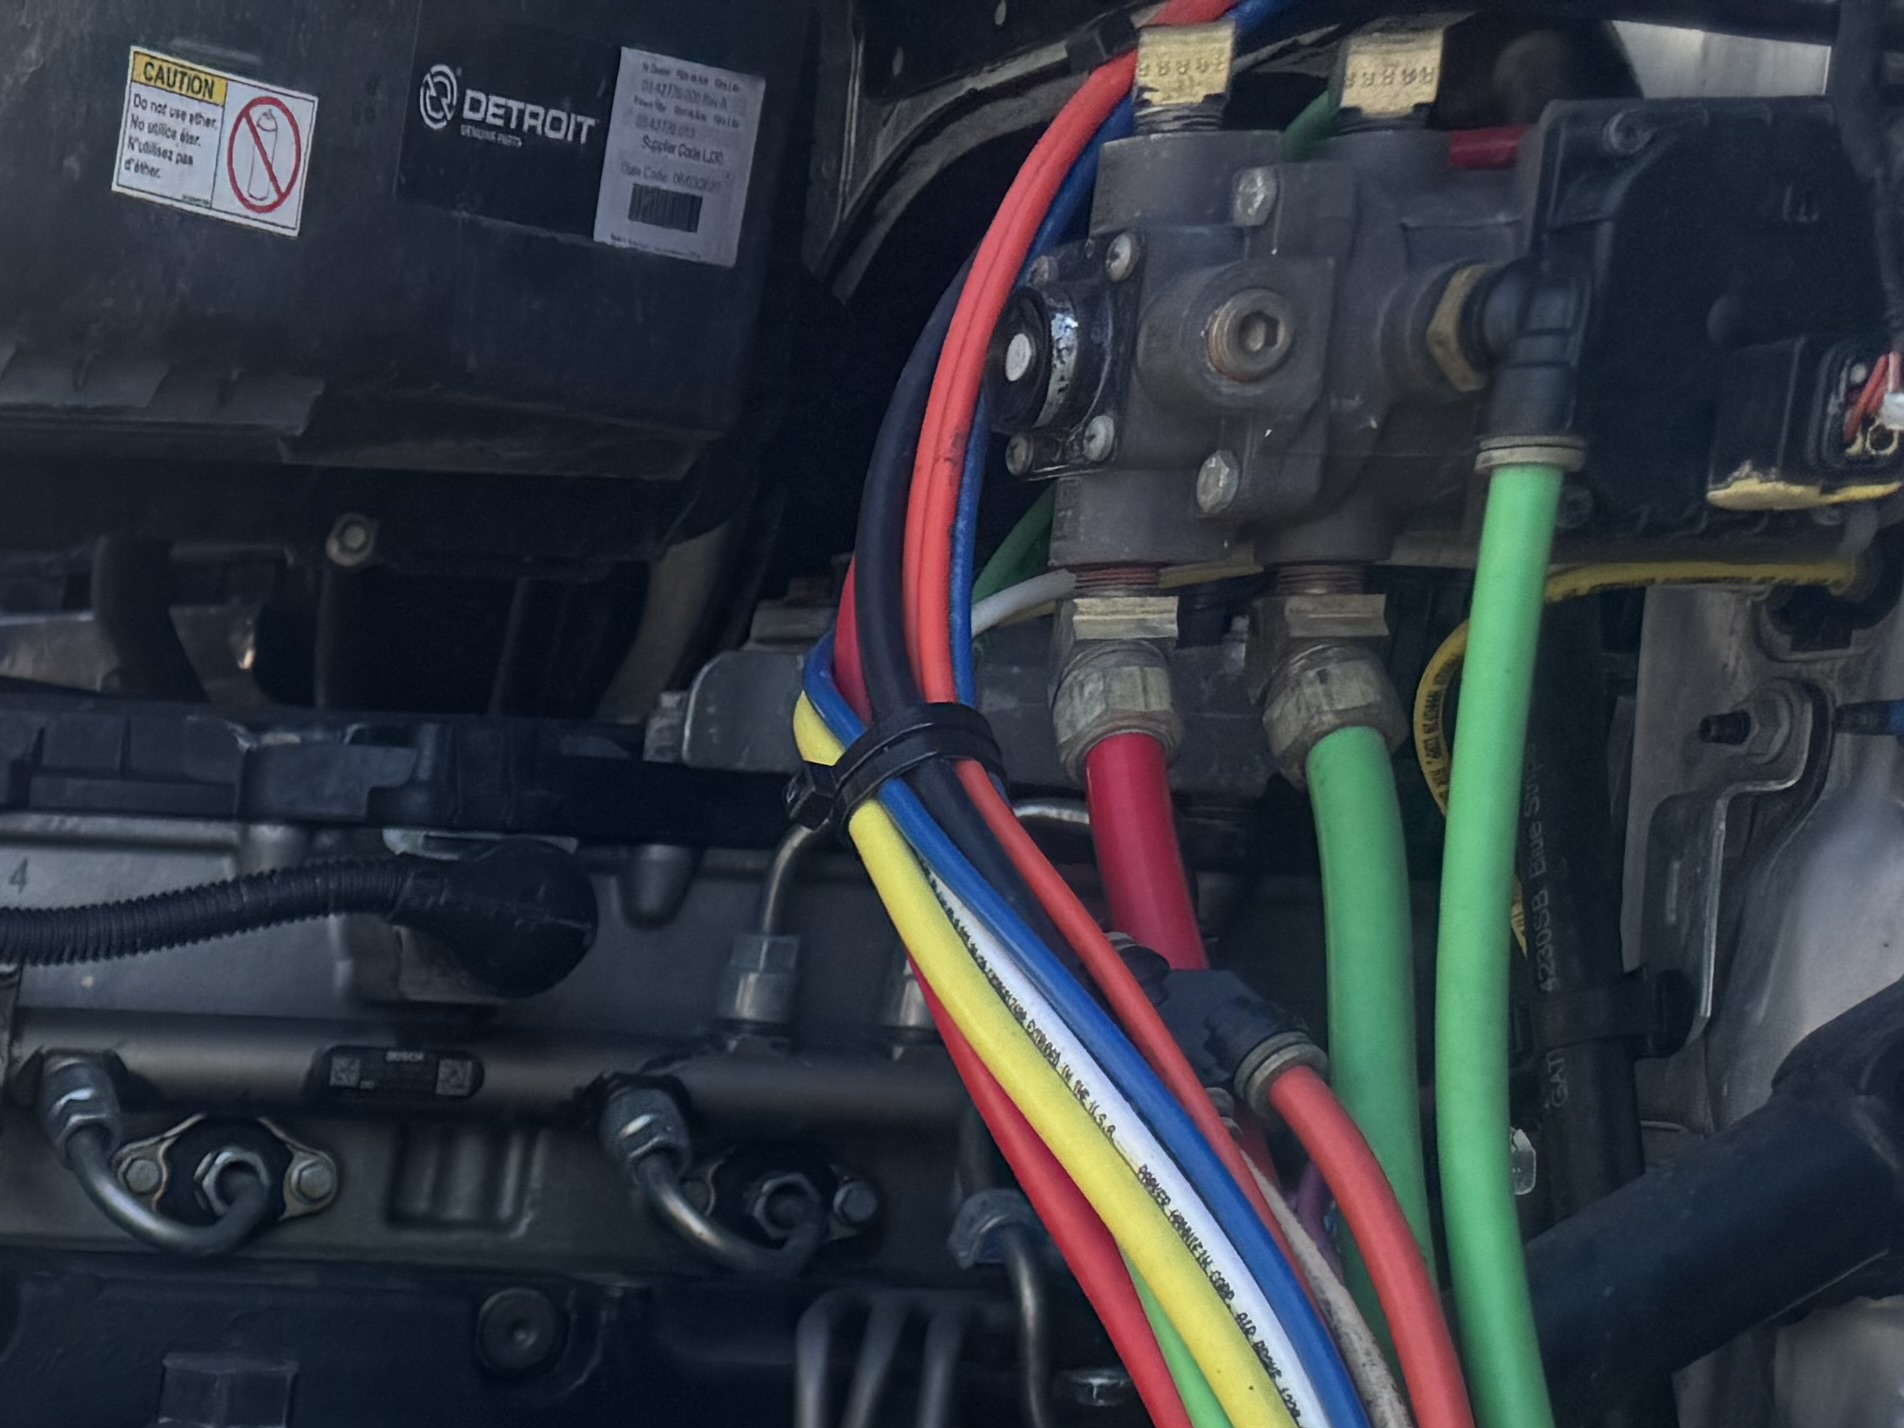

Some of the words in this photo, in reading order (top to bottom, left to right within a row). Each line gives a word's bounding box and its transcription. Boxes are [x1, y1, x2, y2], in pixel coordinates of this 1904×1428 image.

[143, 62, 215, 99] CAUTION
[133, 93, 147, 109] Do
[151, 101, 167, 114] not
[462, 88, 596, 145] DETROIT
[131, 114, 144, 129] No
